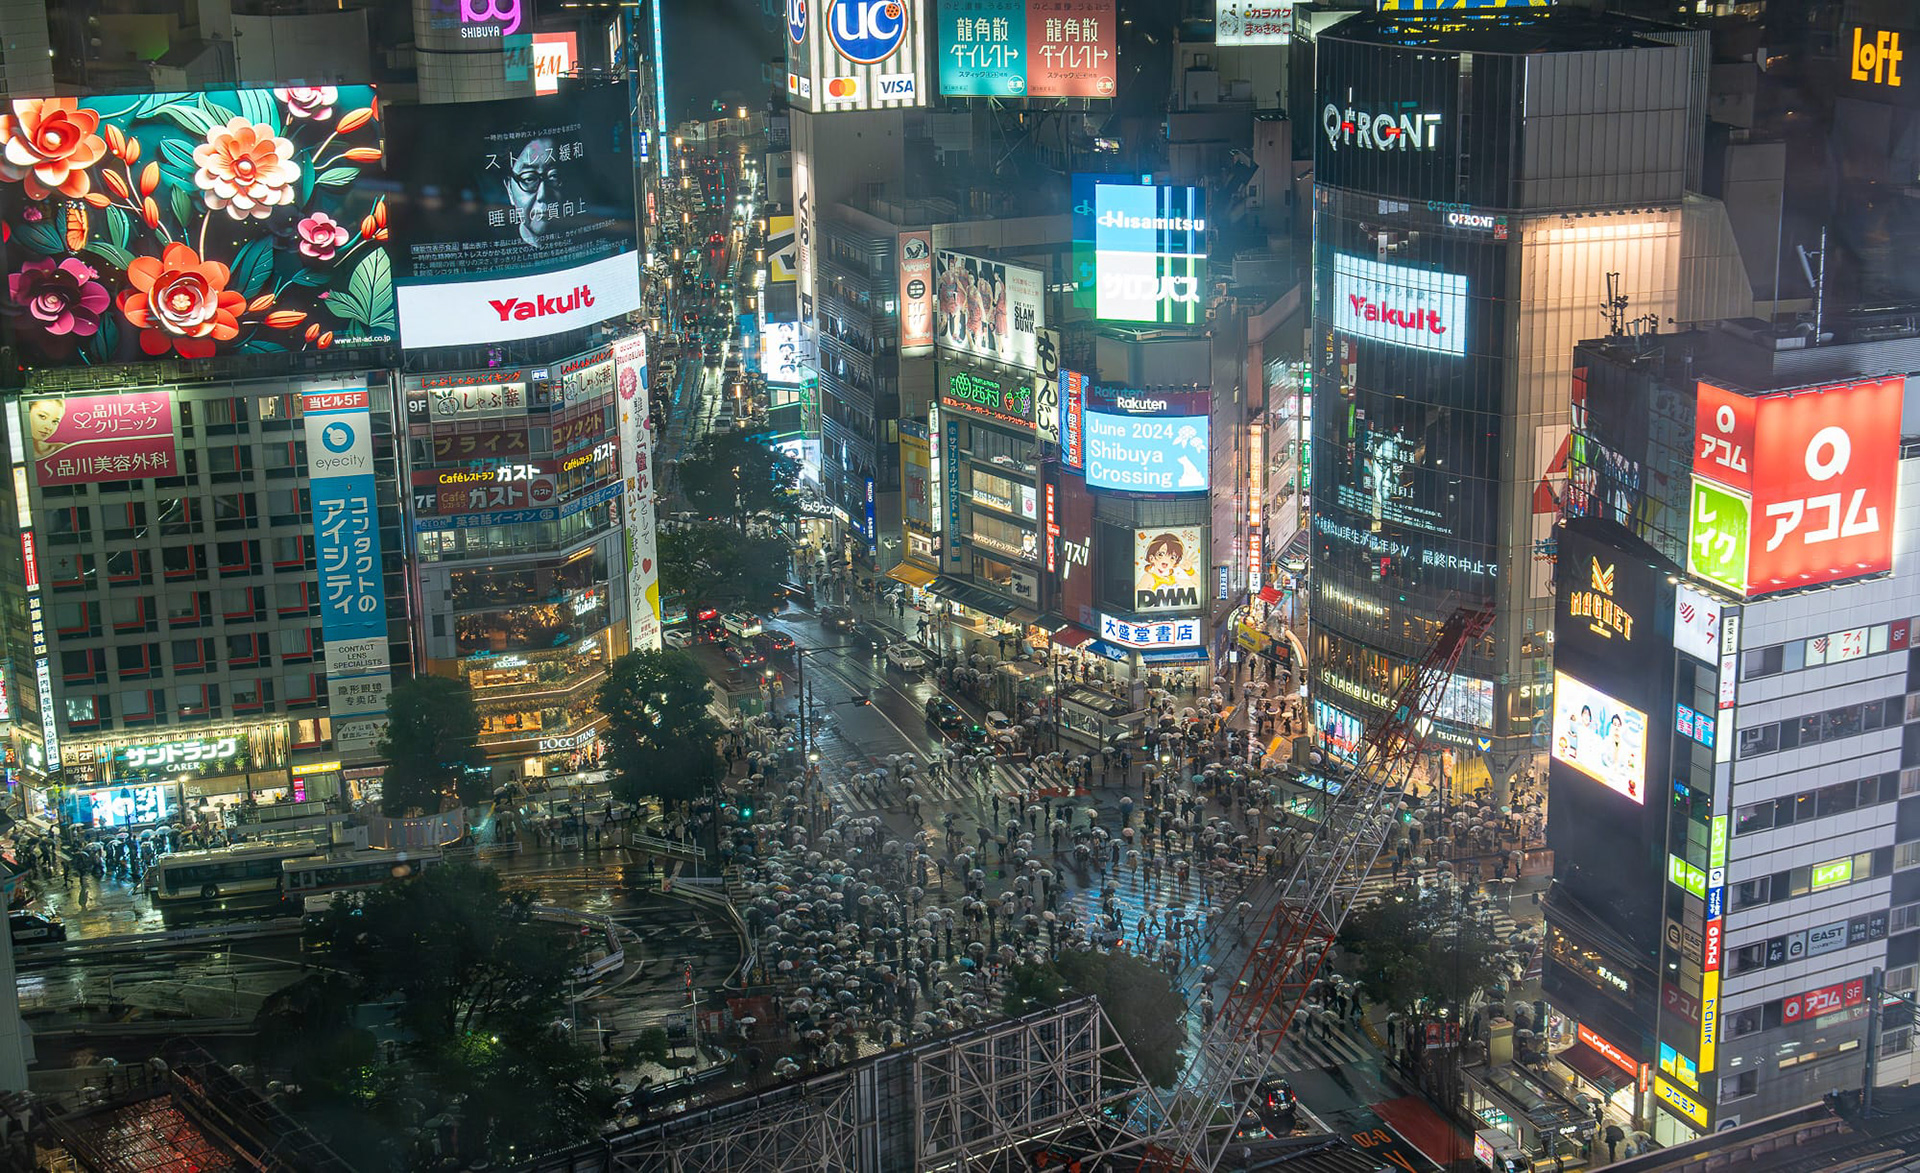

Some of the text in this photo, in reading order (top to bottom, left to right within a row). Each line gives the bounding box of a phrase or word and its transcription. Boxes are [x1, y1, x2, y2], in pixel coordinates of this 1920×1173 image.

[1251, 8, 1291, 19] カラオケ
[460, 25, 501, 39] SHIBUYA
[956, 17, 1009, 43] 龍角散
[1045, 17, 1099, 43] 龍角散
[1244, 22, 1291, 36] まねきねこ
[534, 54, 563, 78] H&M
[950, 44, 1020, 68] ダイレクト
[1038, 45, 1109, 69] ダイレクト
[880, 79, 914, 95] VISA
[1323, 102, 1443, 151] QFRONT
[484, 140, 584, 170] ストレス緩和
[487, 196, 587, 228] 睡眠の質向上
[1099, 210, 1205, 232] Hisamitsu
[1448, 212, 1495, 228] QFRONT
[1101, 273, 1200, 304] サロンパス
[488, 284, 596, 322] Yakult
[1014, 305, 1035, 322] SLAM
[1349, 293, 1447, 335] Yakult
[1014, 317, 1035, 334] DUNK
[334, 333, 392, 346] www.hit-ad.co.jp
[421, 370, 523, 389] しゃぶしゃぶバイキング
[578, 364, 612, 393] しゃぶ葉
[308, 393, 362, 410] 当ビル5F
[408, 400, 427, 413] 9F
[463, 388, 520, 410] しゃぶ葉
[972, 383, 1000, 408] 西村
[1117, 397, 1167, 413] Rakuten
[92, 400, 164, 419] 品川スキン
[93, 416, 159, 434] クリニック
[552, 412, 603, 446] コンタクト
[1091, 419, 1174, 439] June 2024
[434, 432, 526, 456] プライス
[593, 441, 617, 464] ガスト
[1090, 439, 1164, 466] Shibuya
[1700, 432, 1748, 474] アコム
[57, 450, 171, 477] 品川美容外科
[315, 454, 366, 471] eyecity
[496, 464, 541, 483] ガスト
[1090, 463, 1174, 488] Crossing
[414, 494, 437, 509] 7F
[468, 486, 523, 510] ガスト
[456, 511, 536, 528] 英会話イーオン
[1694, 491, 1737, 564] レイク
[1765, 488, 1880, 553] アコム
[318, 498, 354, 615] アイシティ
[350, 496, 378, 613] コンタクトの
[1064, 536, 1091, 580] クスリ
[1137, 586, 1198, 608] DMM
[1570, 590, 1634, 641] MAGNET
[1105, 619, 1194, 643] 大盛堂書店
[338, 643, 375, 654] CONTACT
[347, 652, 367, 660] LENS
[333, 658, 383, 670] SPECIALISTS
[1320, 667, 1400, 711] STARBUCKS
[1436, 729, 1474, 747] TSUTAYA
[79, 751, 93, 762] 2F
[128, 736, 237, 768] サンドラッグ
[1675, 860, 1706, 890] レイク
[1817, 863, 1847, 884] レイク
[1811, 926, 1845, 943] EAST
[1806, 990, 1841, 1018] アコム
[1703, 998, 1716, 1045] プロミス
[1665, 1086, 1697, 1116] プロミス
